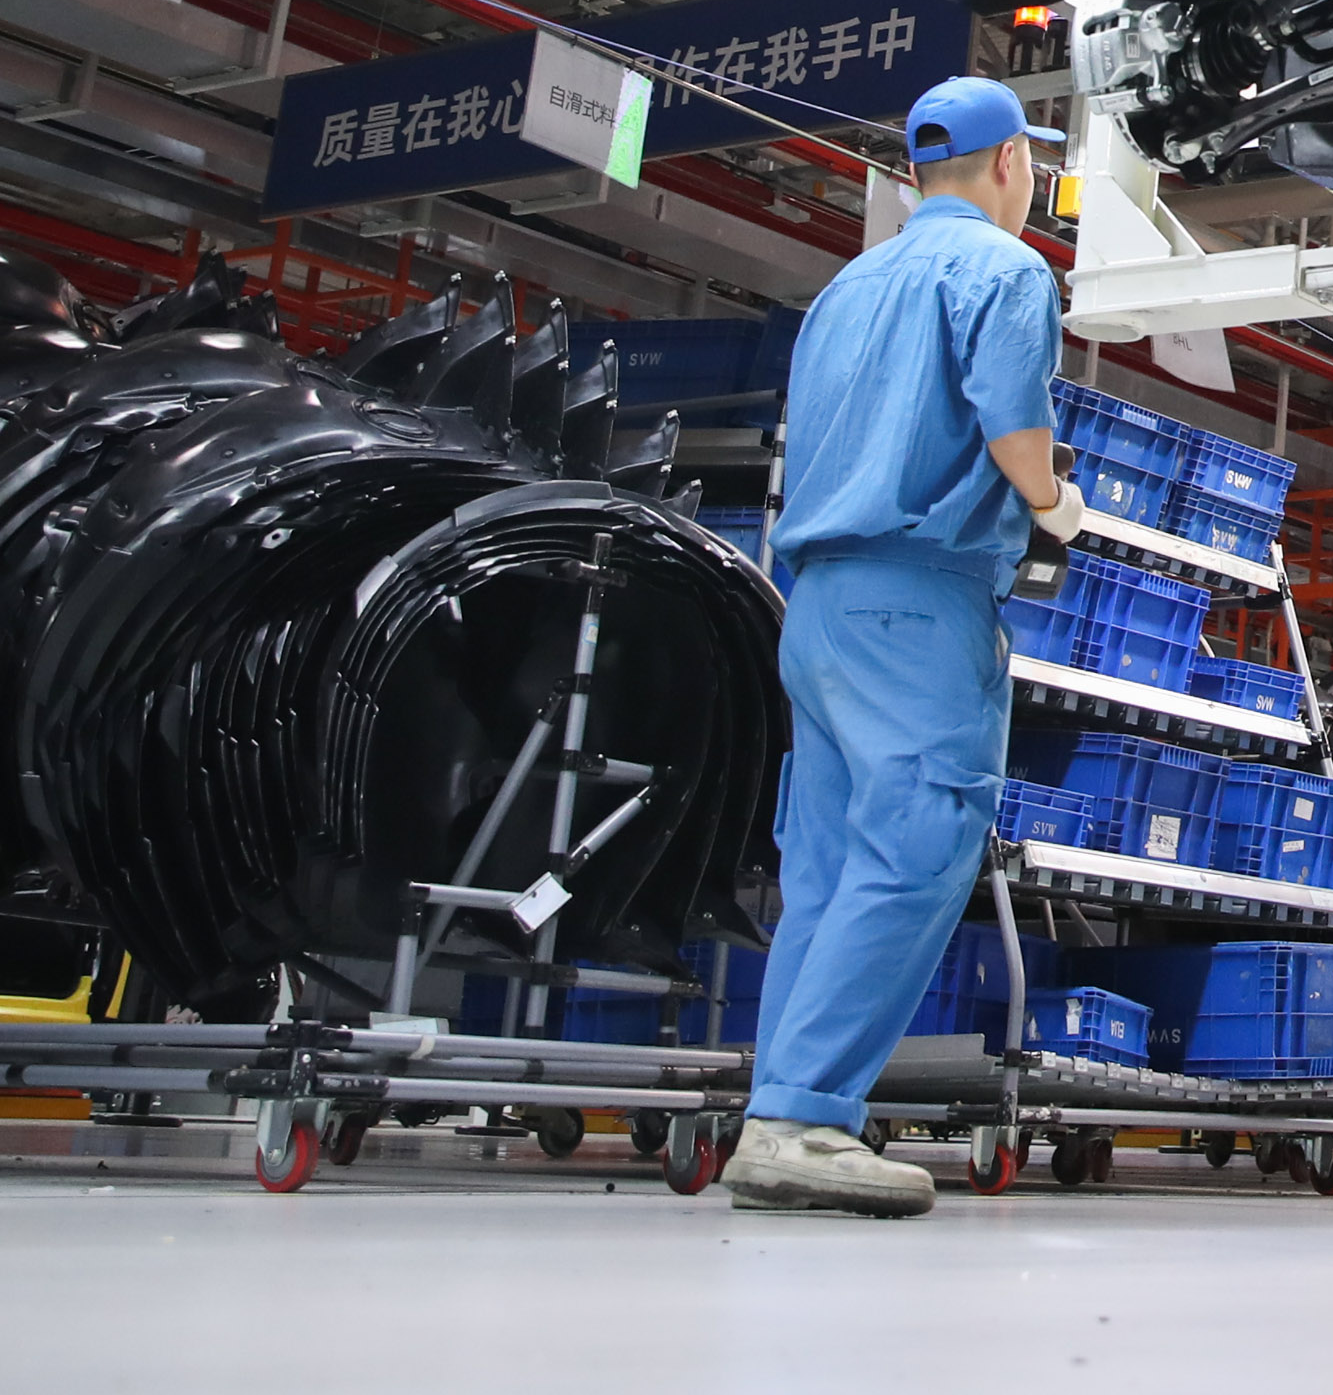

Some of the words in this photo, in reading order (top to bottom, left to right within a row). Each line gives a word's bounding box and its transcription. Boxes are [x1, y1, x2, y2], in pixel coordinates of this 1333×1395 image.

[550, 85, 622, 129] 自滑式料
[313, 79, 529, 168] 质量在我心
[629, 352, 662, 367] SVW
[1226, 470, 1253, 490] SVW
[1256, 695, 1275, 712] SVW
[1032, 821, 1057, 837] SVW
